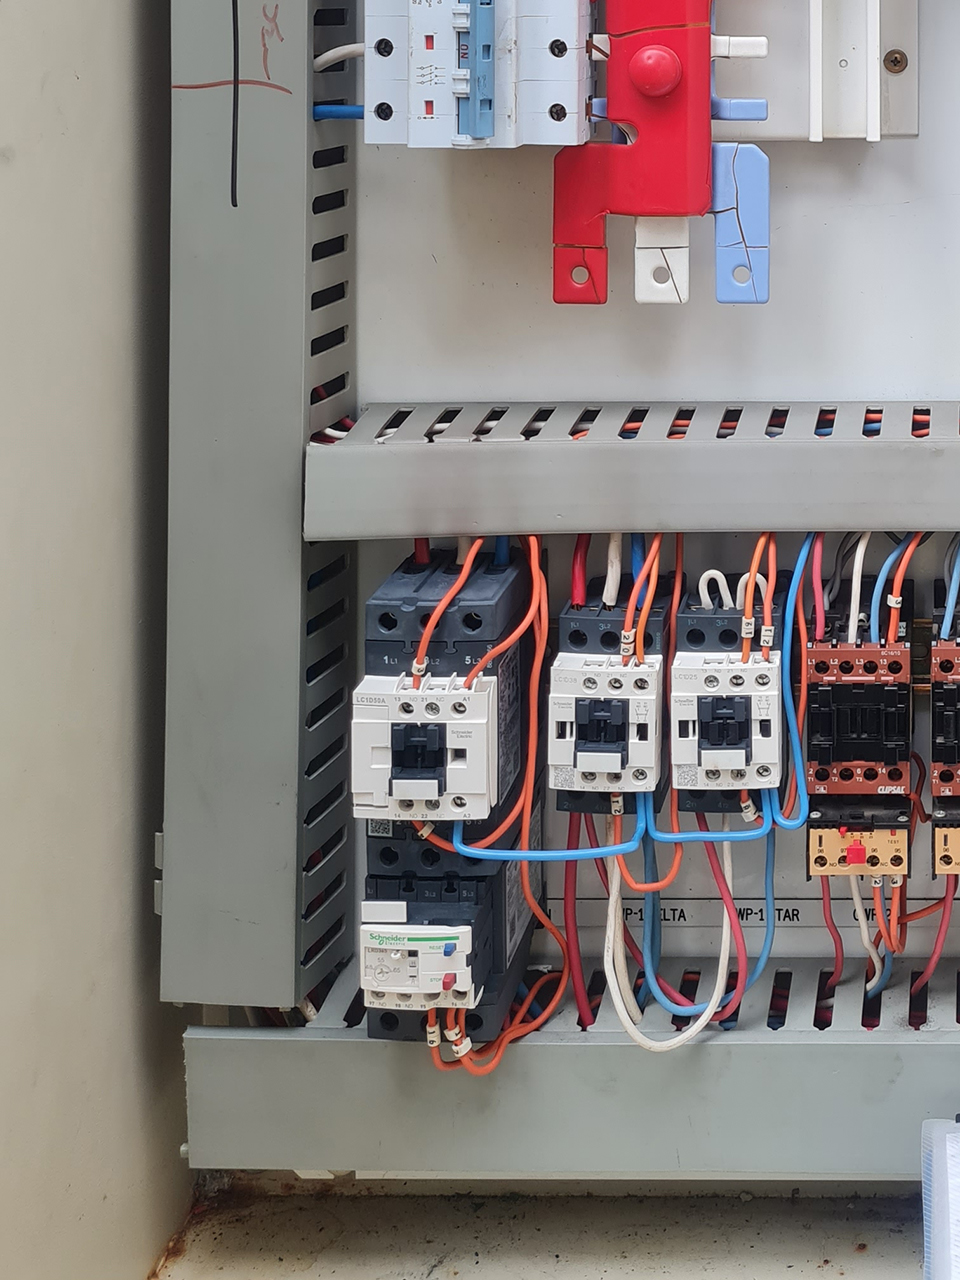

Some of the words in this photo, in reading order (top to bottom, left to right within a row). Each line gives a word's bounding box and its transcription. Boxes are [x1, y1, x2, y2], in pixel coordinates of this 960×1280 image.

[461, 43, 468, 60] ON
[356, 696, 386, 704] LC1D50A
[878, 786, 906, 794] CLIPSAL
[369, 933, 406, 945] Schneider
